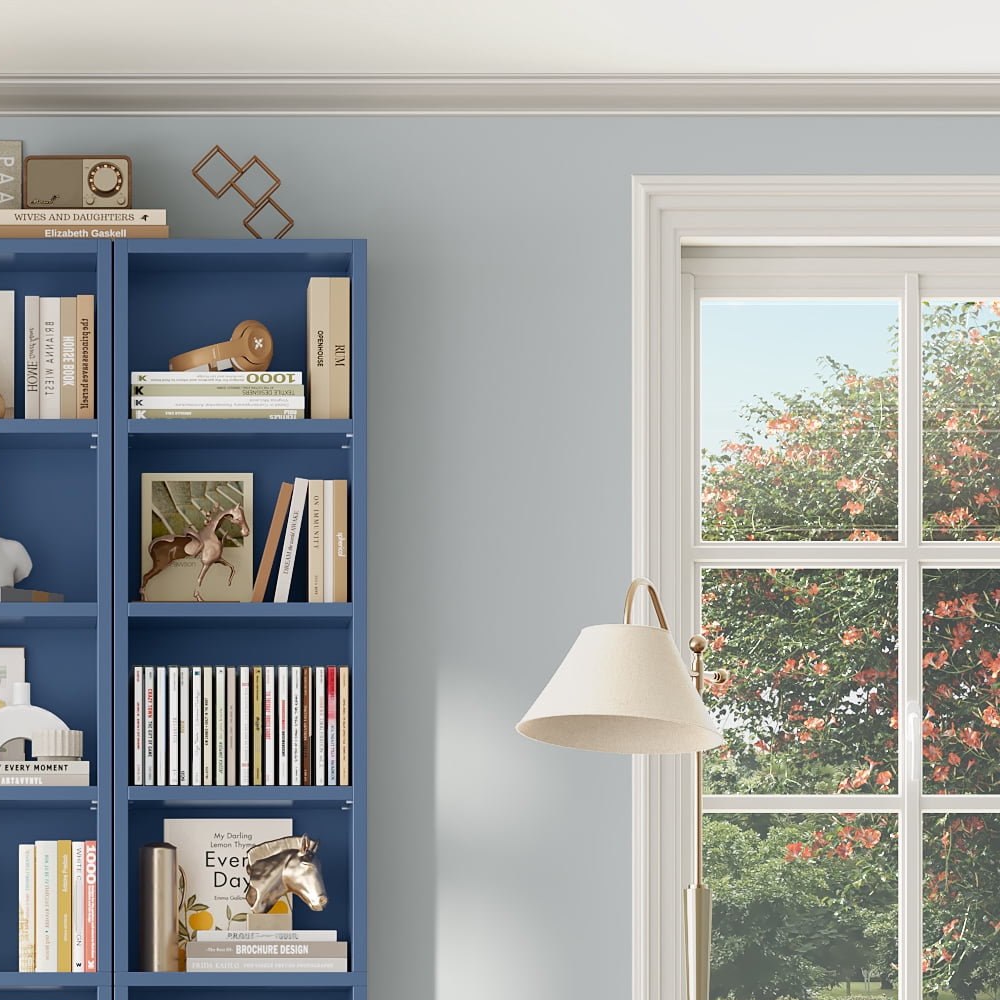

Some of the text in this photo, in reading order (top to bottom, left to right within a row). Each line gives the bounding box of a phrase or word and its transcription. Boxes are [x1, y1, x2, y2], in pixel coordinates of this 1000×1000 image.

[14, 213, 135, 221] WIVES AND DAUGHTERS
[44, 229, 127, 238] Elizabeth Gaskell
[246, 373, 296, 383] 1000
[4, 764, 31, 772] EVERY
[34, 764, 69, 772] MOMENT
[213, 832, 253, 841] My Darling
[205, 851, 248, 868] Ever
[86, 845, 97, 885] 1000
[213, 871, 250, 893] Day
[235, 944, 309, 955] BROCHURE DESIGN
